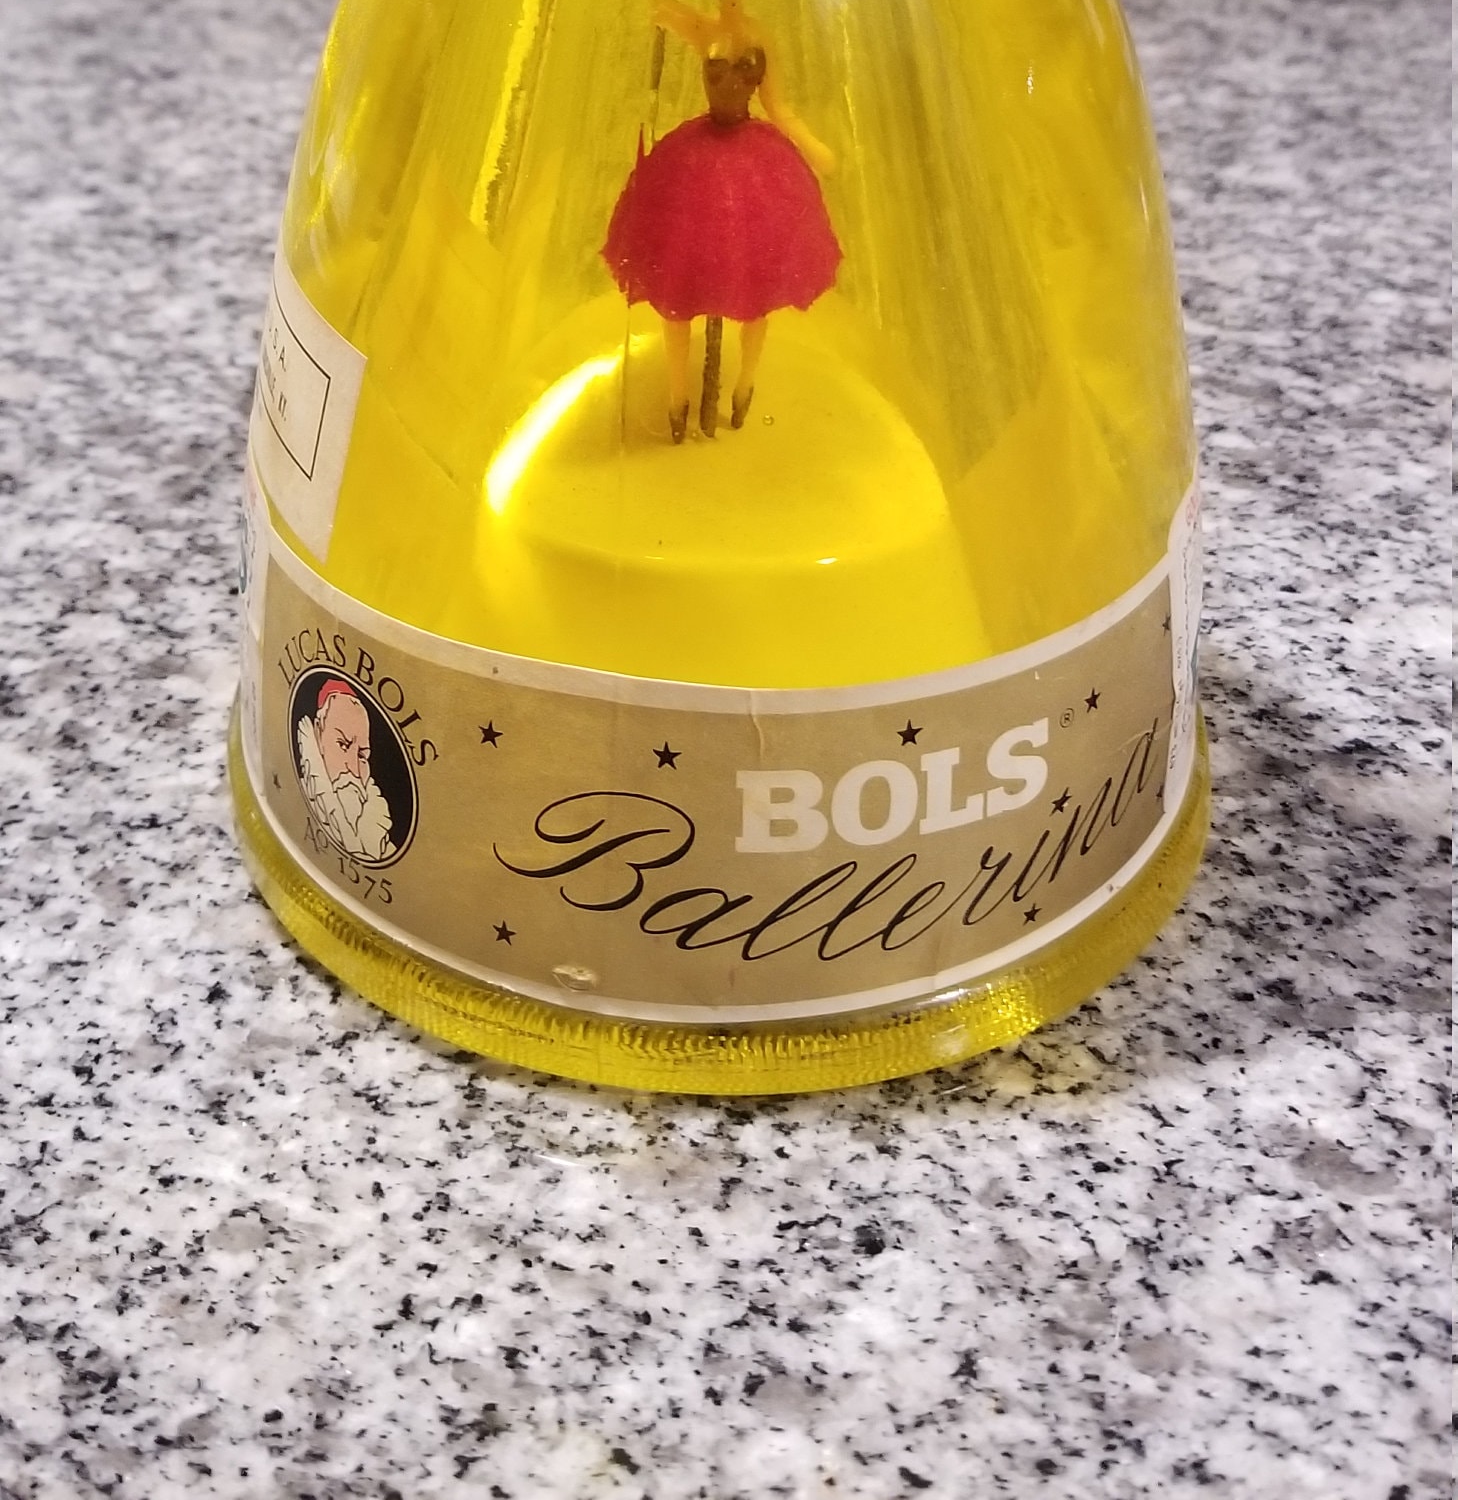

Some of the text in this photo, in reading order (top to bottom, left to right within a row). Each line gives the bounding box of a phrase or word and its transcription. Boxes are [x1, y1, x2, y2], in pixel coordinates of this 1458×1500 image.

[277, 627, 347, 688] LUCAS
[354, 646, 439, 768] BOLS
[492, 716, 1160, 962] Ballerina
[734, 717, 1049, 854] BOLS
[338, 856, 393, 905] 1575
